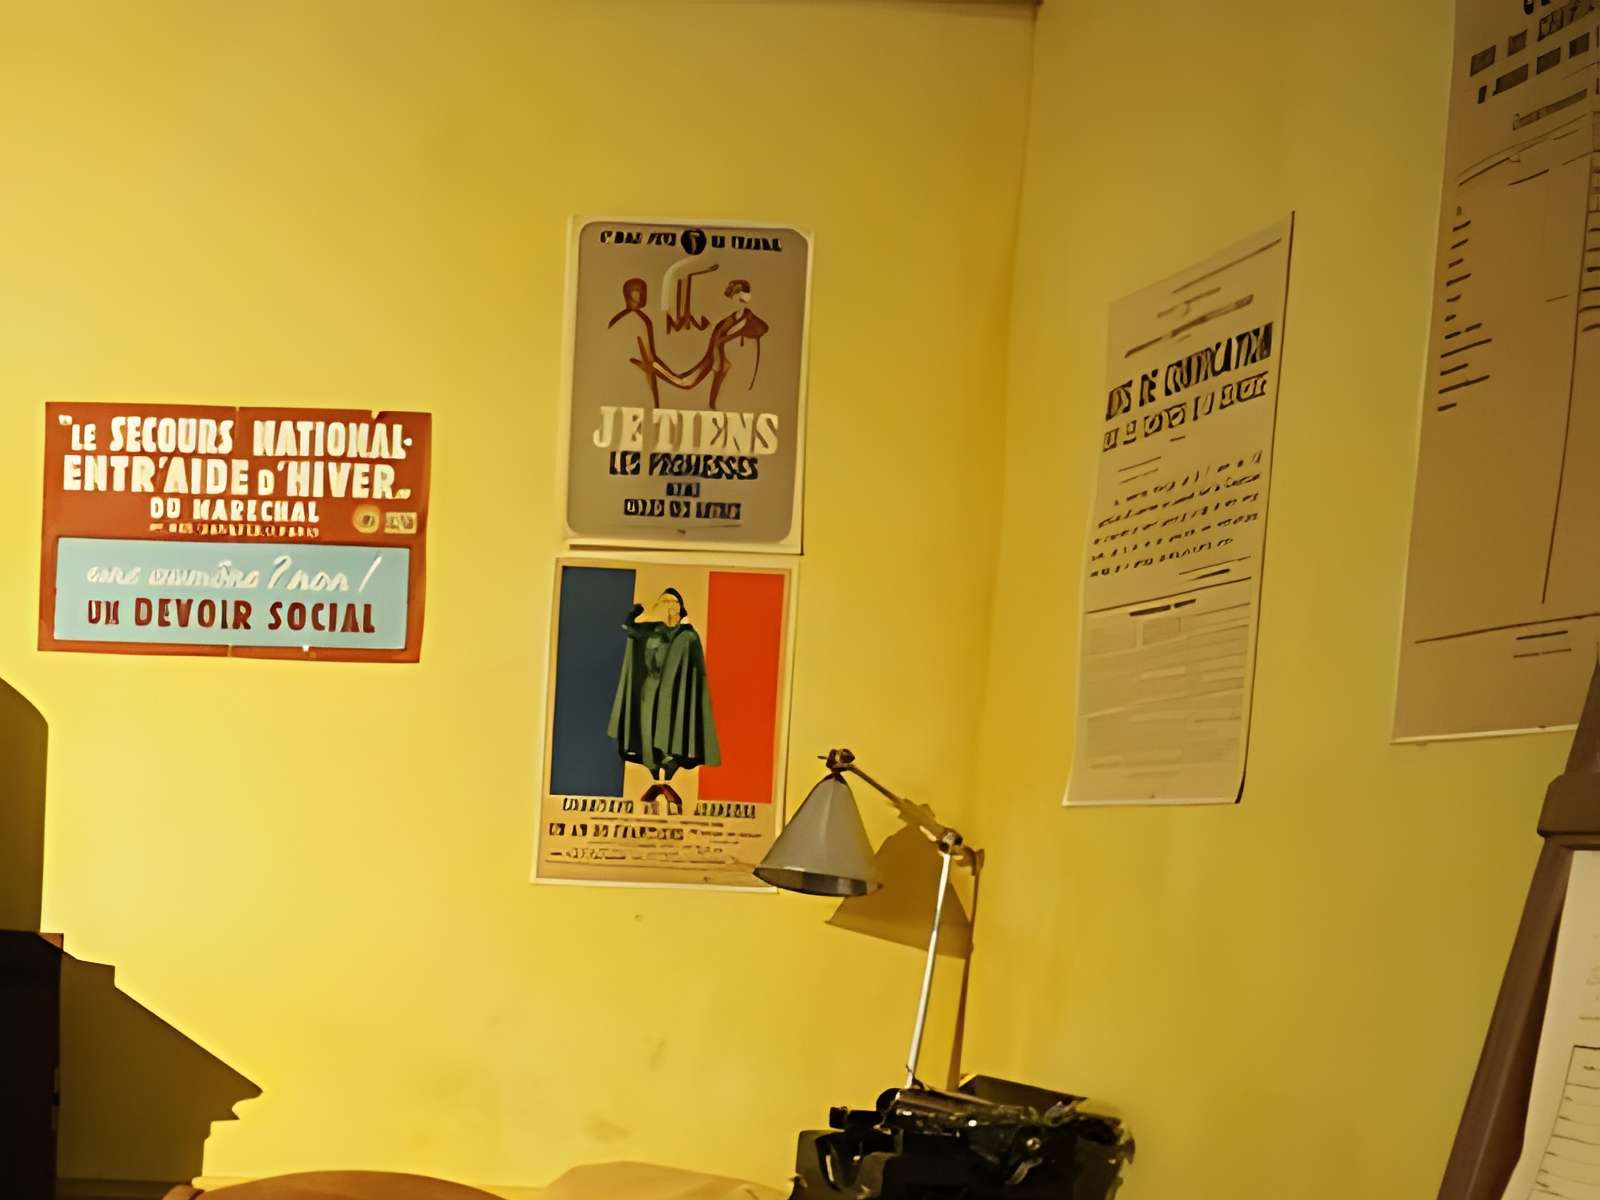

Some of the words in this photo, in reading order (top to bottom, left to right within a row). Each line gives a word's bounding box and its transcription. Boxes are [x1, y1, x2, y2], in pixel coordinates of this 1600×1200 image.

[110, 415, 235, 455] SECOURS
[592, 406, 644, 449] JE
[652, 408, 779, 455] TIENS
[63, 454, 249, 496] ENTR'AIDE
[87, 599, 120, 626] UN
[134, 597, 252, 630] DEVOIR
[267, 601, 376, 634] SOCIAL
